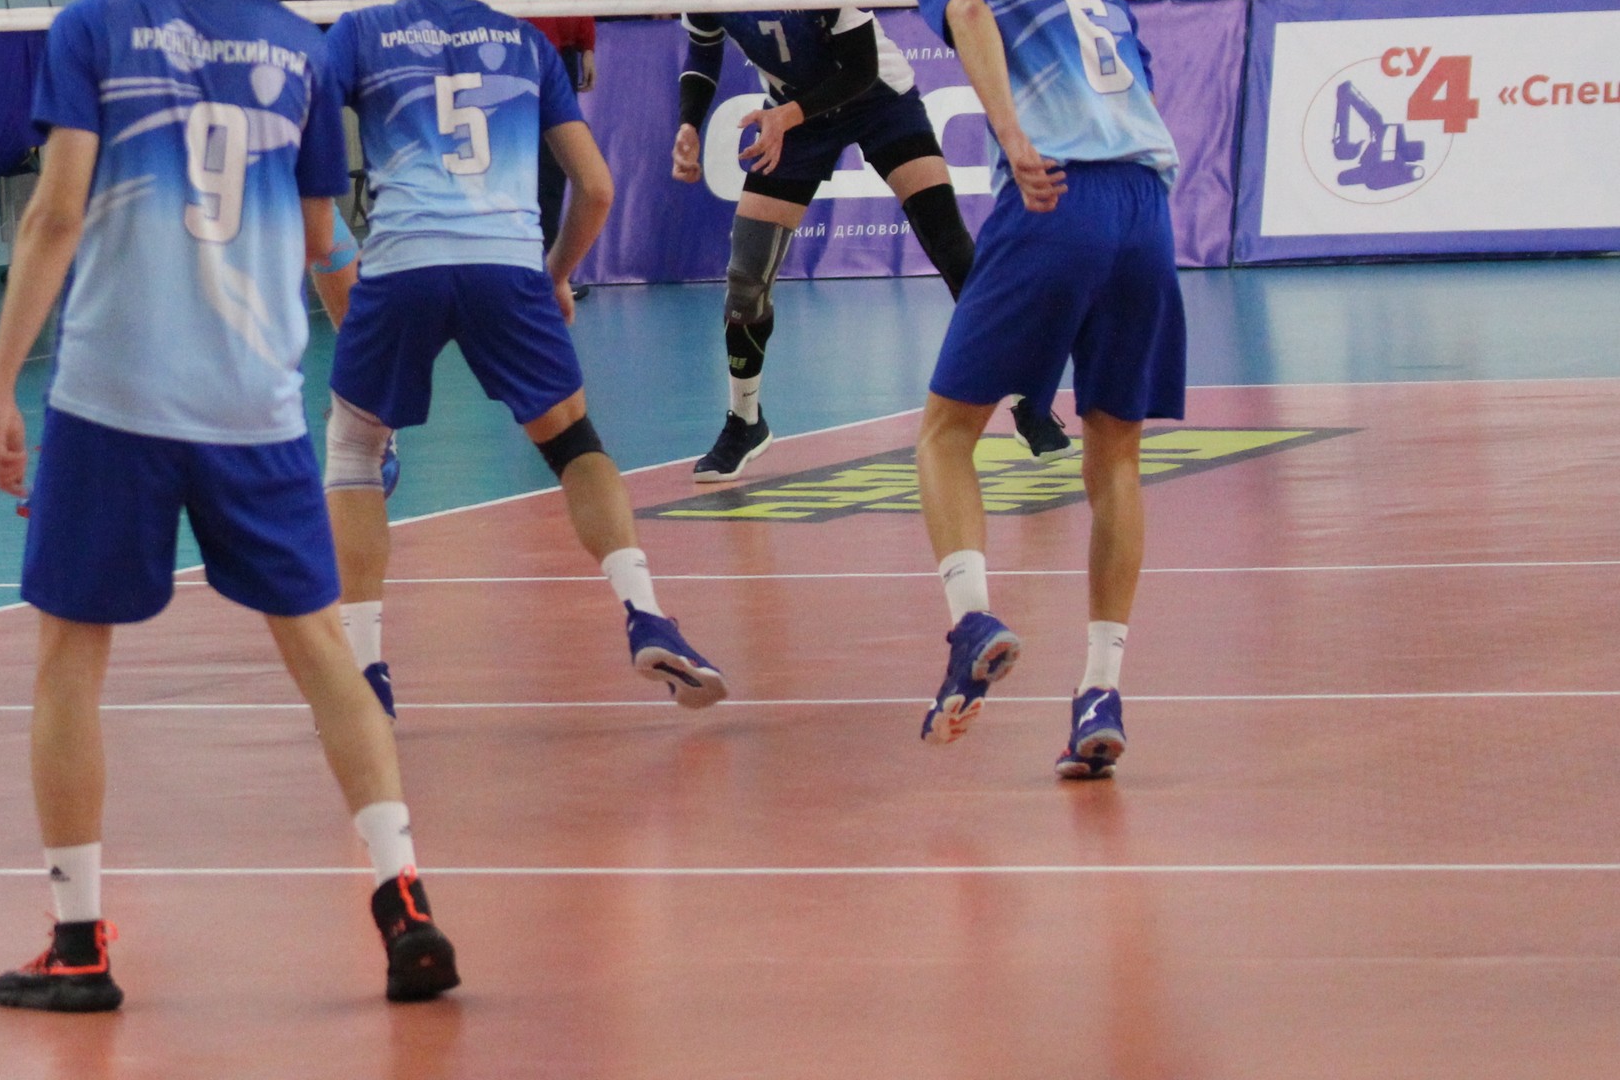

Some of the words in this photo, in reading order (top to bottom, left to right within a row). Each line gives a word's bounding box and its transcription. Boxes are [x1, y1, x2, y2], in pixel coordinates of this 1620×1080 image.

[489, 28, 522, 46] КРАЙ
[758, 20, 791, 63] 7
[1381, 46, 1432, 77] СУ
[1406, 55, 1480, 133] 4
[434, 72, 492, 175] 5
[184, 101, 250, 244] 9
[834, 220, 911, 238] ДЕЛОВОЙ
